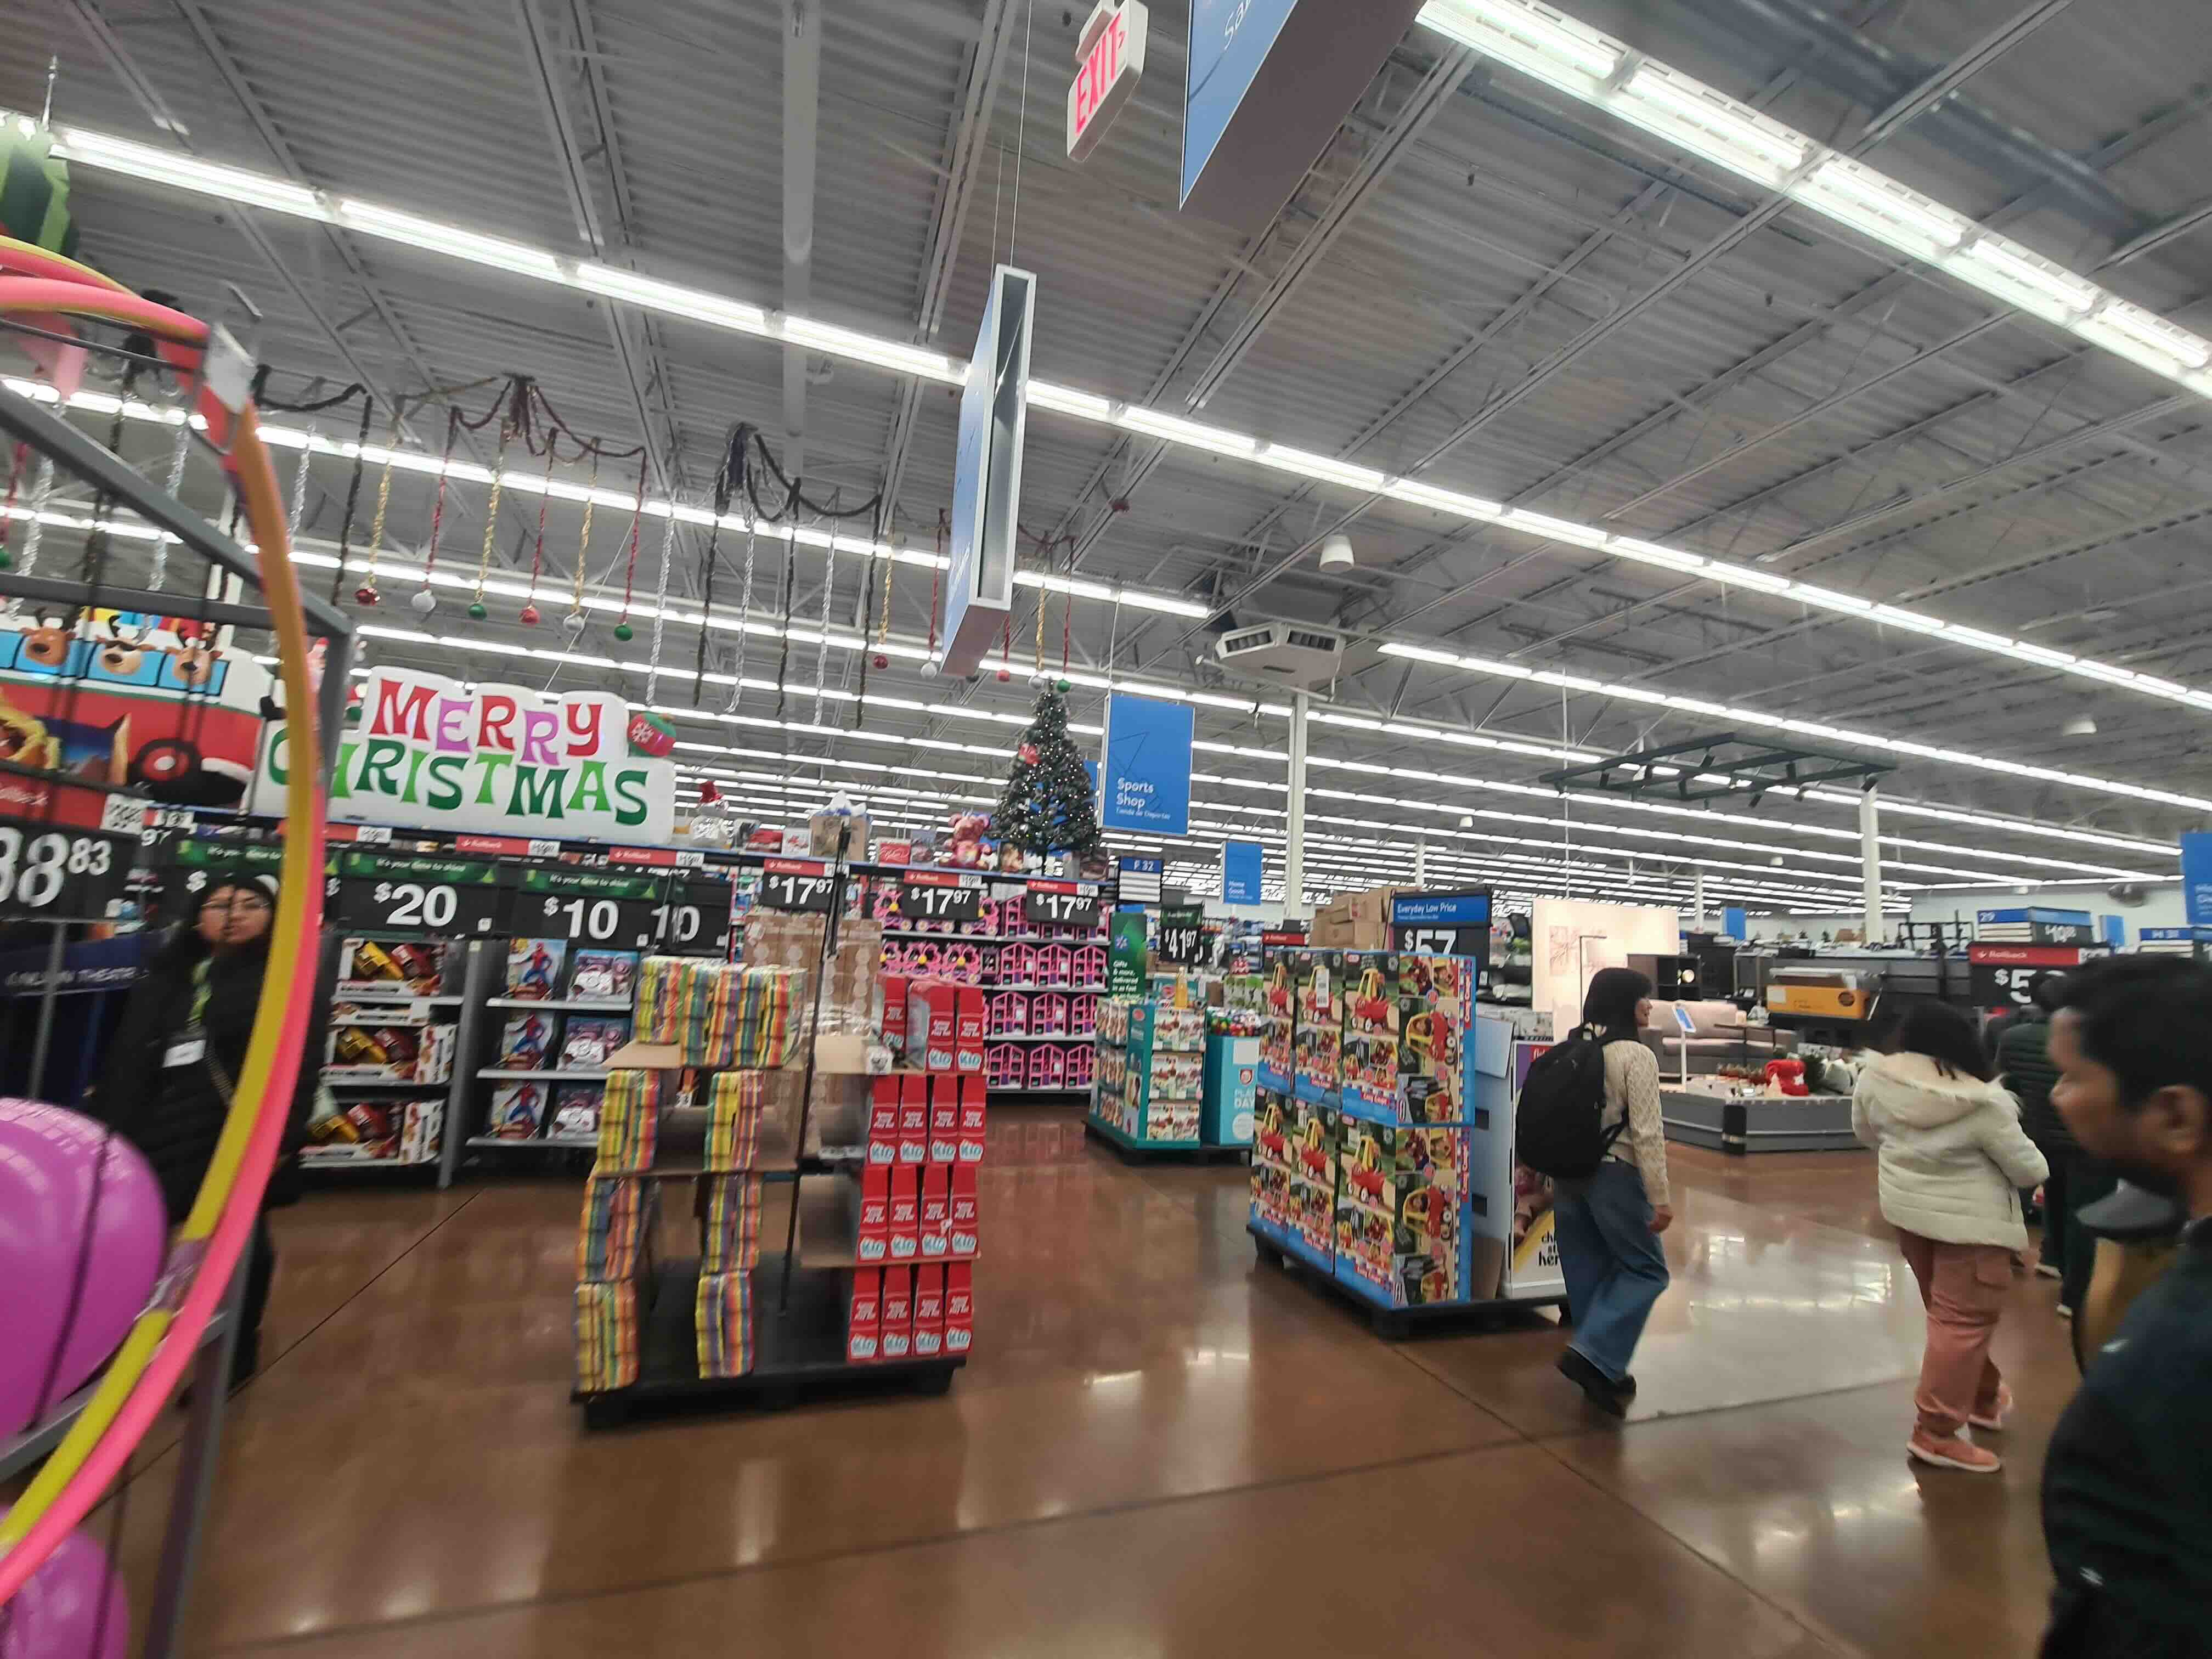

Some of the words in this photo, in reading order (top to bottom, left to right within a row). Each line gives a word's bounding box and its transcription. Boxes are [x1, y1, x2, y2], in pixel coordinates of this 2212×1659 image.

[1076, 11, 1122, 136] EXIT
[369, 678, 603, 766] MERRY
[1116, 793, 1145, 809] Shop
[1118, 777, 1154, 793] Sports
[373, 881, 458, 927] $20
[543, 896, 619, 939] $10
[1397, 904, 1425, 915] Everyday
[1426, 904, 1438, 913] Low
[1440, 902, 1457, 913] Price
[1989, 950, 2028, 958] Rollback
[1994, 968, 2067, 1003] $5
